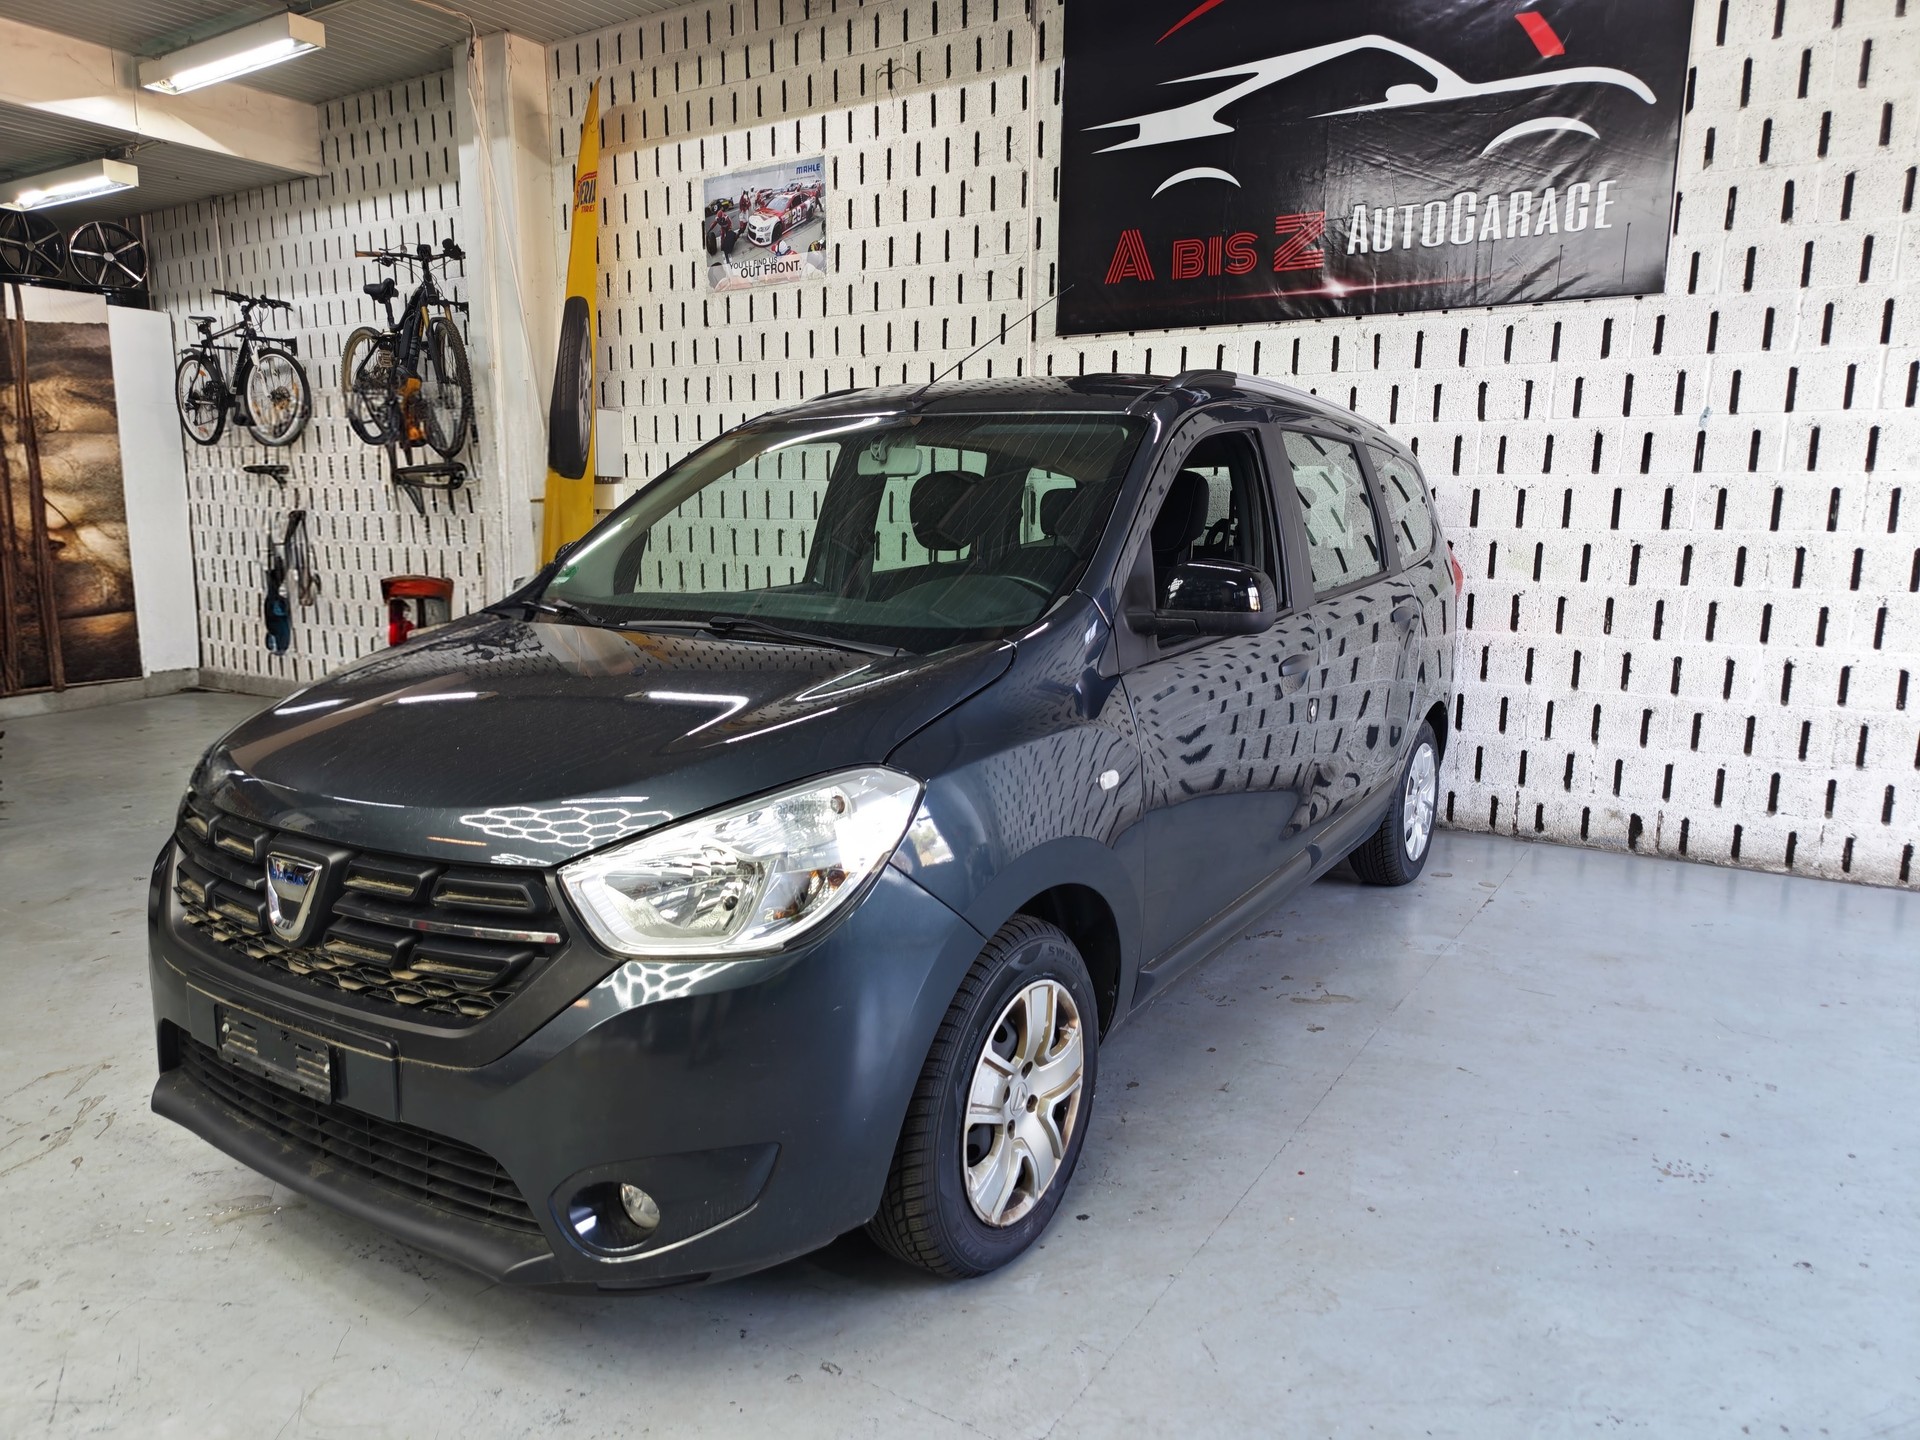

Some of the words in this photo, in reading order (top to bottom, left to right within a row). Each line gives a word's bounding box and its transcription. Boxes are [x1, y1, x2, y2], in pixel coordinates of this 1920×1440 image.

[796, 163, 821, 174] MAHLE
[1105, 229, 1155, 284] A
[1172, 232, 1259, 281] BIS
[1273, 211, 1326, 272] Z
[753, 258, 768, 266] FIND
[769, 256, 778, 264] US
[741, 265, 760, 279] OUT
[764, 260, 802, 275] FRONT.
